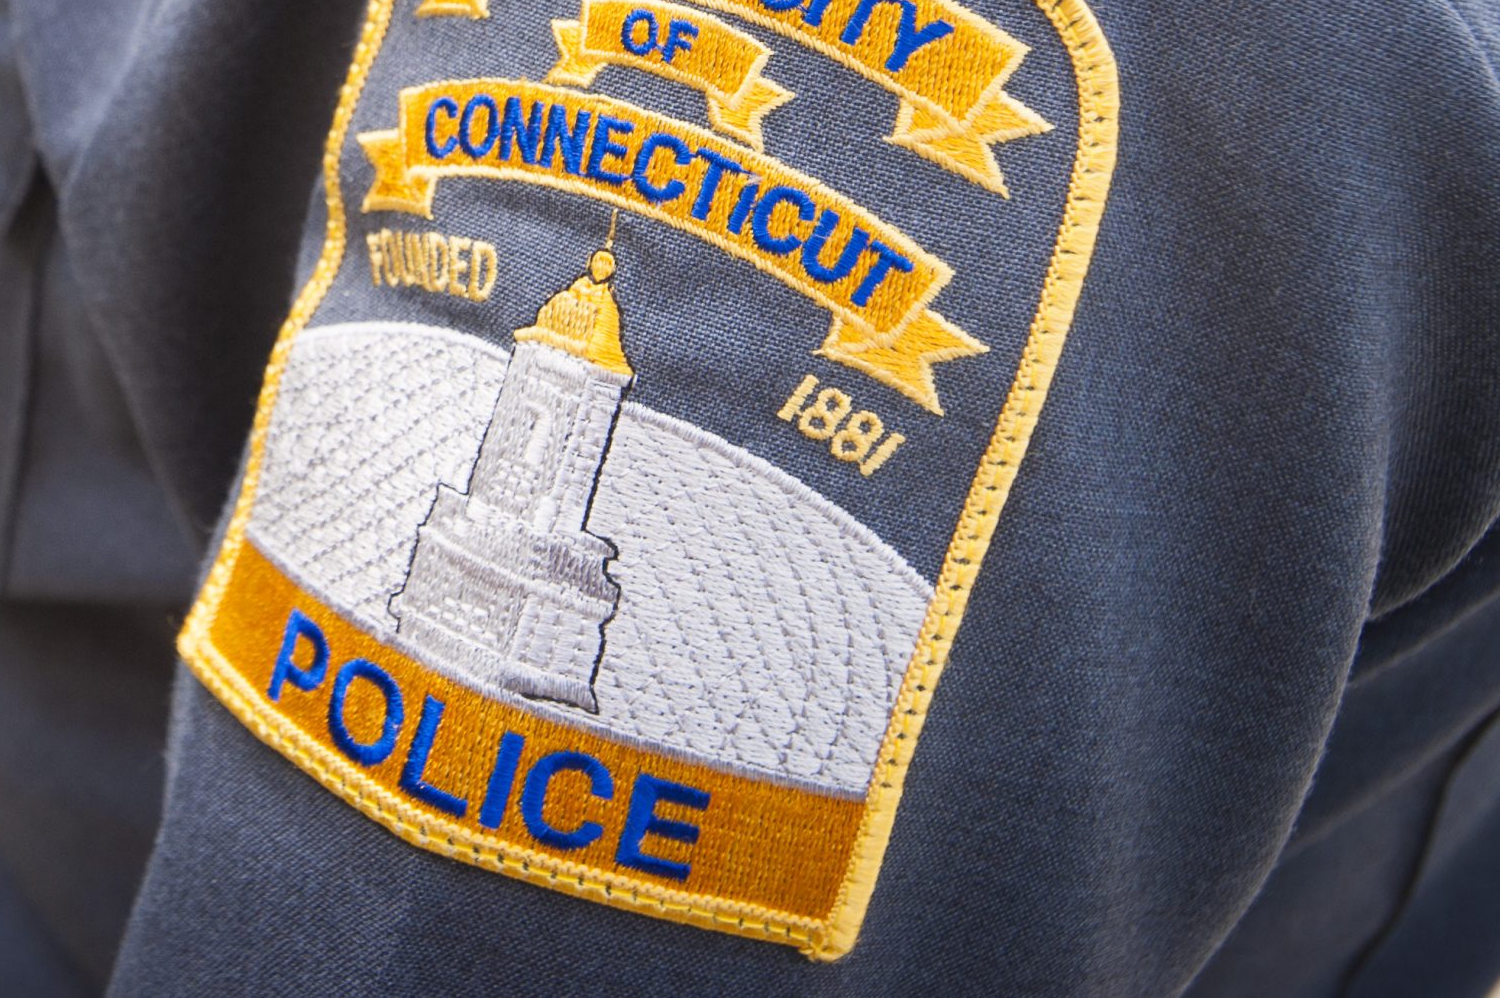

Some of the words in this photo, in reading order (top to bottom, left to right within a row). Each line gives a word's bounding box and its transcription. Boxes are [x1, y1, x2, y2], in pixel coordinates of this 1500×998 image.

[620, 8, 700, 61] OF
[424, 96, 915, 307] CONNECTICUT
[366, 228, 498, 303] FOUNDED
[776, 374, 906, 477] 1881
[268, 608, 711, 880] POLICE
